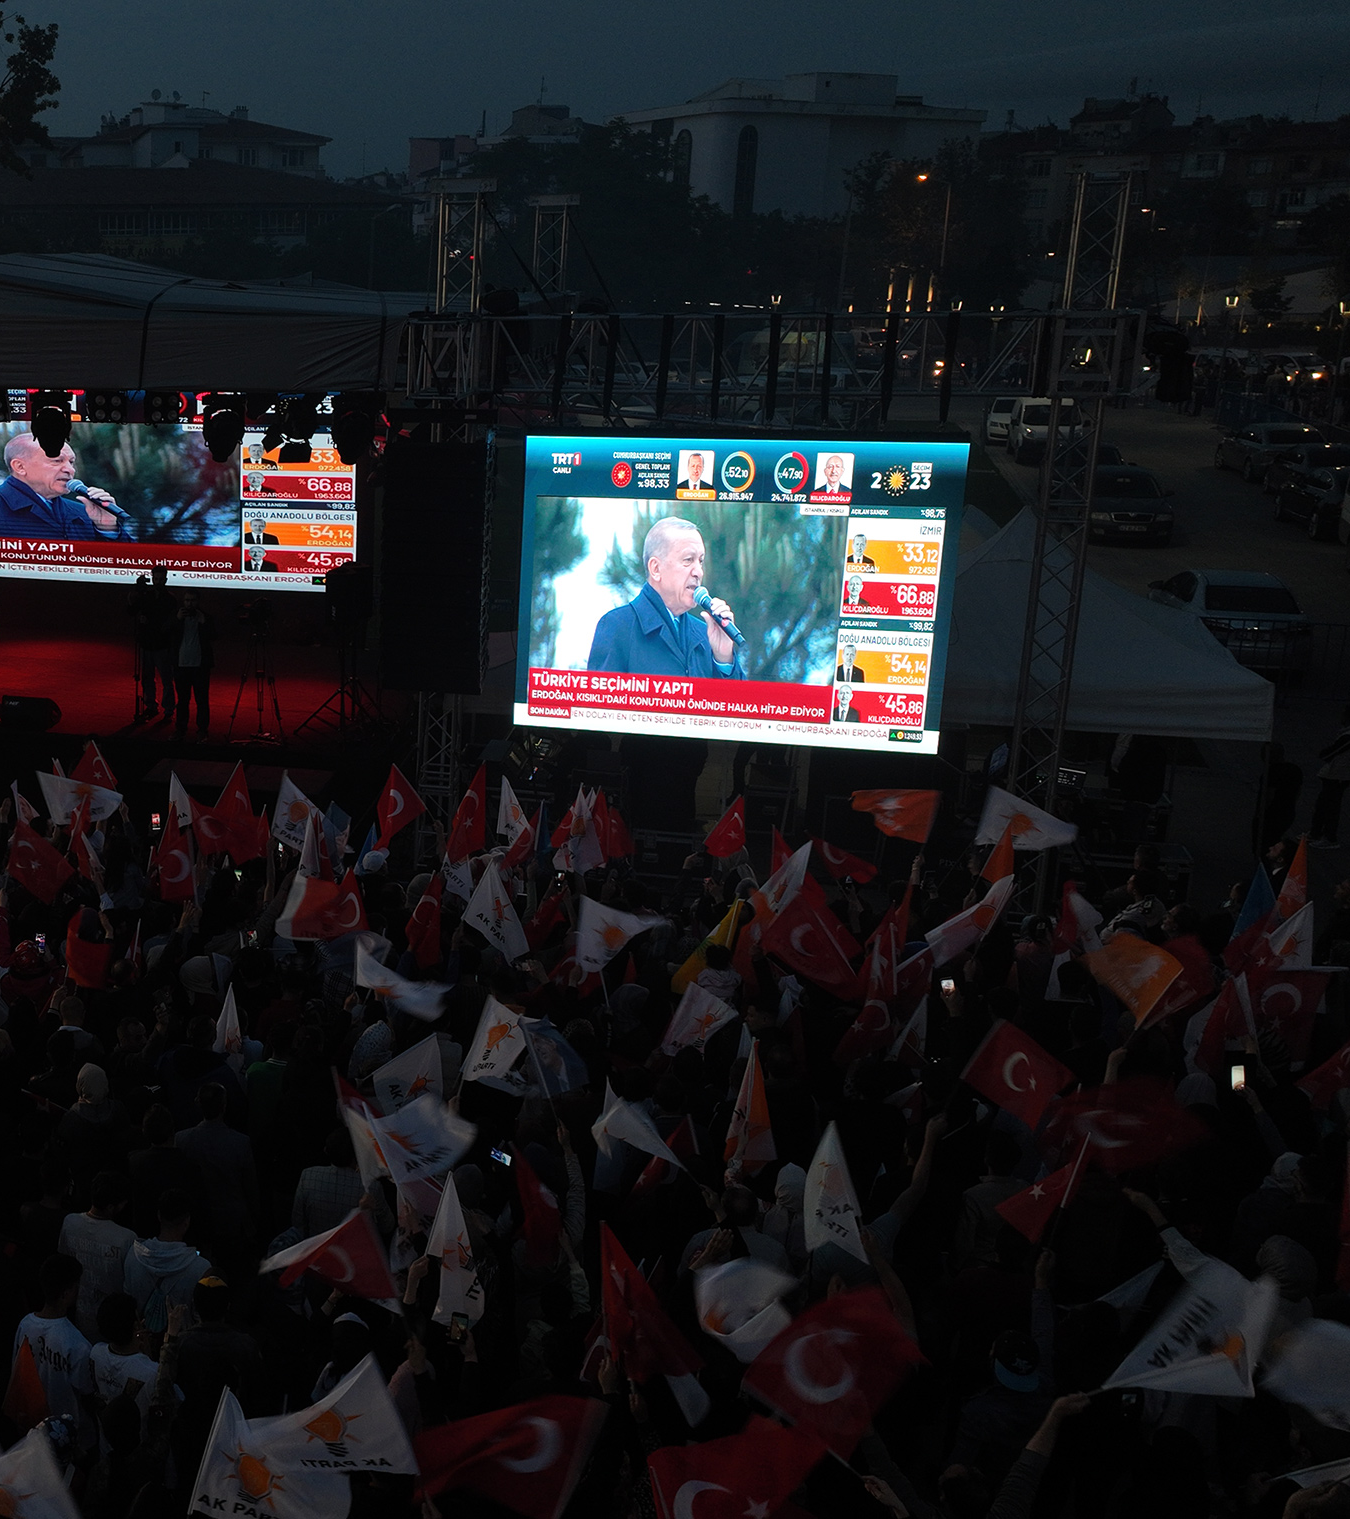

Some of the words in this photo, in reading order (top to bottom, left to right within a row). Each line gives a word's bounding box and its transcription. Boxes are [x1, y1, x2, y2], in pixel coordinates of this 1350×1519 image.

[298, 478, 351, 492] %66,88
[244, 511, 269, 519] DOĞU
[269, 512, 314, 520] ANADOLU
[301, 525, 352, 539] %54,14
[26, 542, 74, 553] YAPTI
[307, 539, 351, 547] ERDOĞAN
[1, 552, 67, 562] KONUTUNUN
[69, 554, 114, 565] ÖNÜNDE
[116, 557, 153, 566] HALKA
[156, 557, 188, 567] HİTAP
[191, 559, 233, 569] EDİYOR
[897, 543, 938, 564] %33,12
[847, 564, 880, 573] ERDOĞAN
[182, 572, 271, 583] CUMHURBAŞKANI
[274, 575, 311, 584] ERDOĞ
[890, 585, 935, 605] %66,88
[861, 635, 896, 645] ANADOLU
[884, 653, 926, 674] %54,14
[532, 671, 588, 689] TÜRKİYE
[591, 675, 650, 693] SEÇİMİNİ
[652, 681, 694, 696] YAPTI
[887, 675, 925, 684] ERDOĞAN
[531, 689, 575, 702] ERDOĞAN,
[629, 696, 686, 709] KONUTUNUN
[687, 699, 727, 711] ÖNÜNDE
[728, 703, 757, 713] HALKA
[760, 703, 788, 715] HİTAP
[790, 706, 825, 717] EDİYOR
[878, 694, 923, 715] %45,86
[530, 707, 545, 715] SON
[546, 707, 569, 717] DAKİKA
[868, 715, 921, 725] KILIÇDAROĞLU
[280, 829, 304, 845] PART
[476, 913, 490, 927] AK
[490, 926, 507, 945] PAR
[388, 1083, 403, 1099] AK
[198, 1493, 226, 1512] AK
[233, 1501, 278, 1519] PAR
